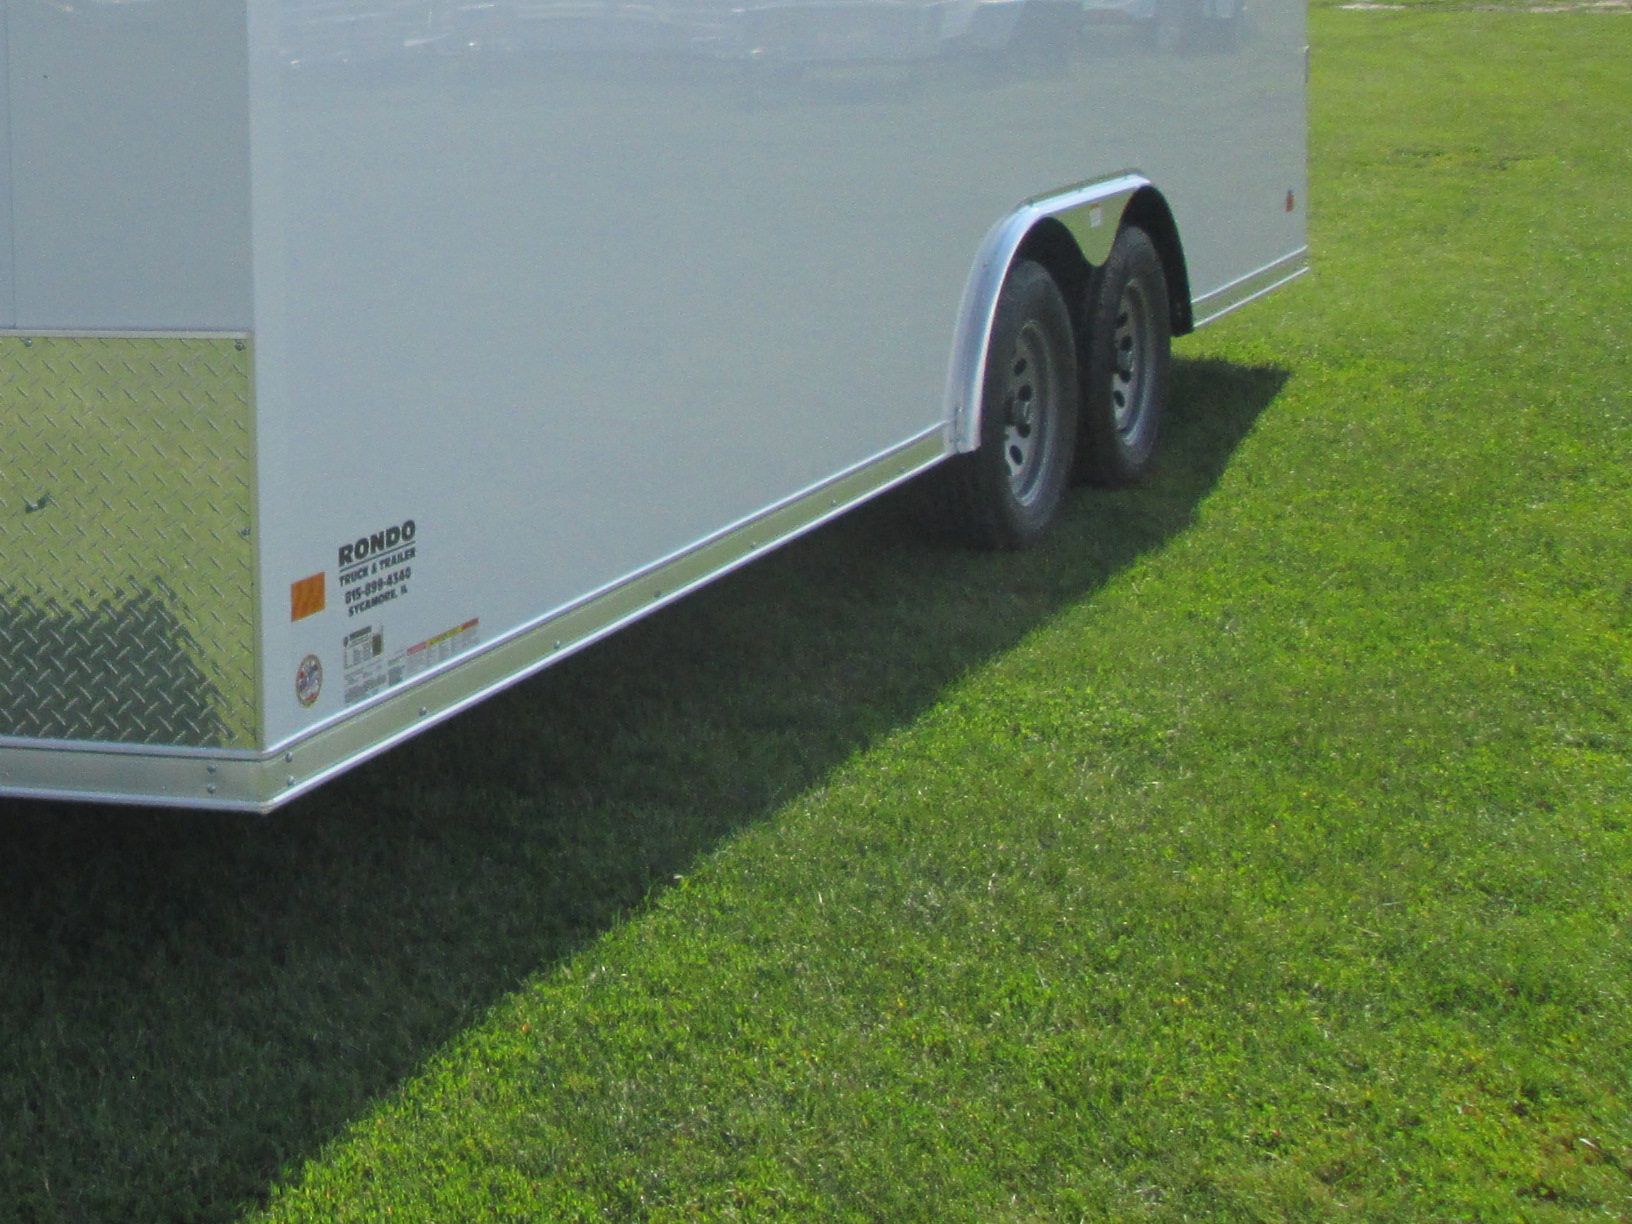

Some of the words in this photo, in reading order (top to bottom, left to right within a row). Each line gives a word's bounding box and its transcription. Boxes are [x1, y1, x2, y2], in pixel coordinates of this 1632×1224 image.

[338, 519, 416, 568] RONDO
[339, 566, 369, 587] TRUCK
[371, 562, 377, 574] &
[379, 547, 416, 570] TRAILER
[348, 588, 398, 618] SYCAMORE,
